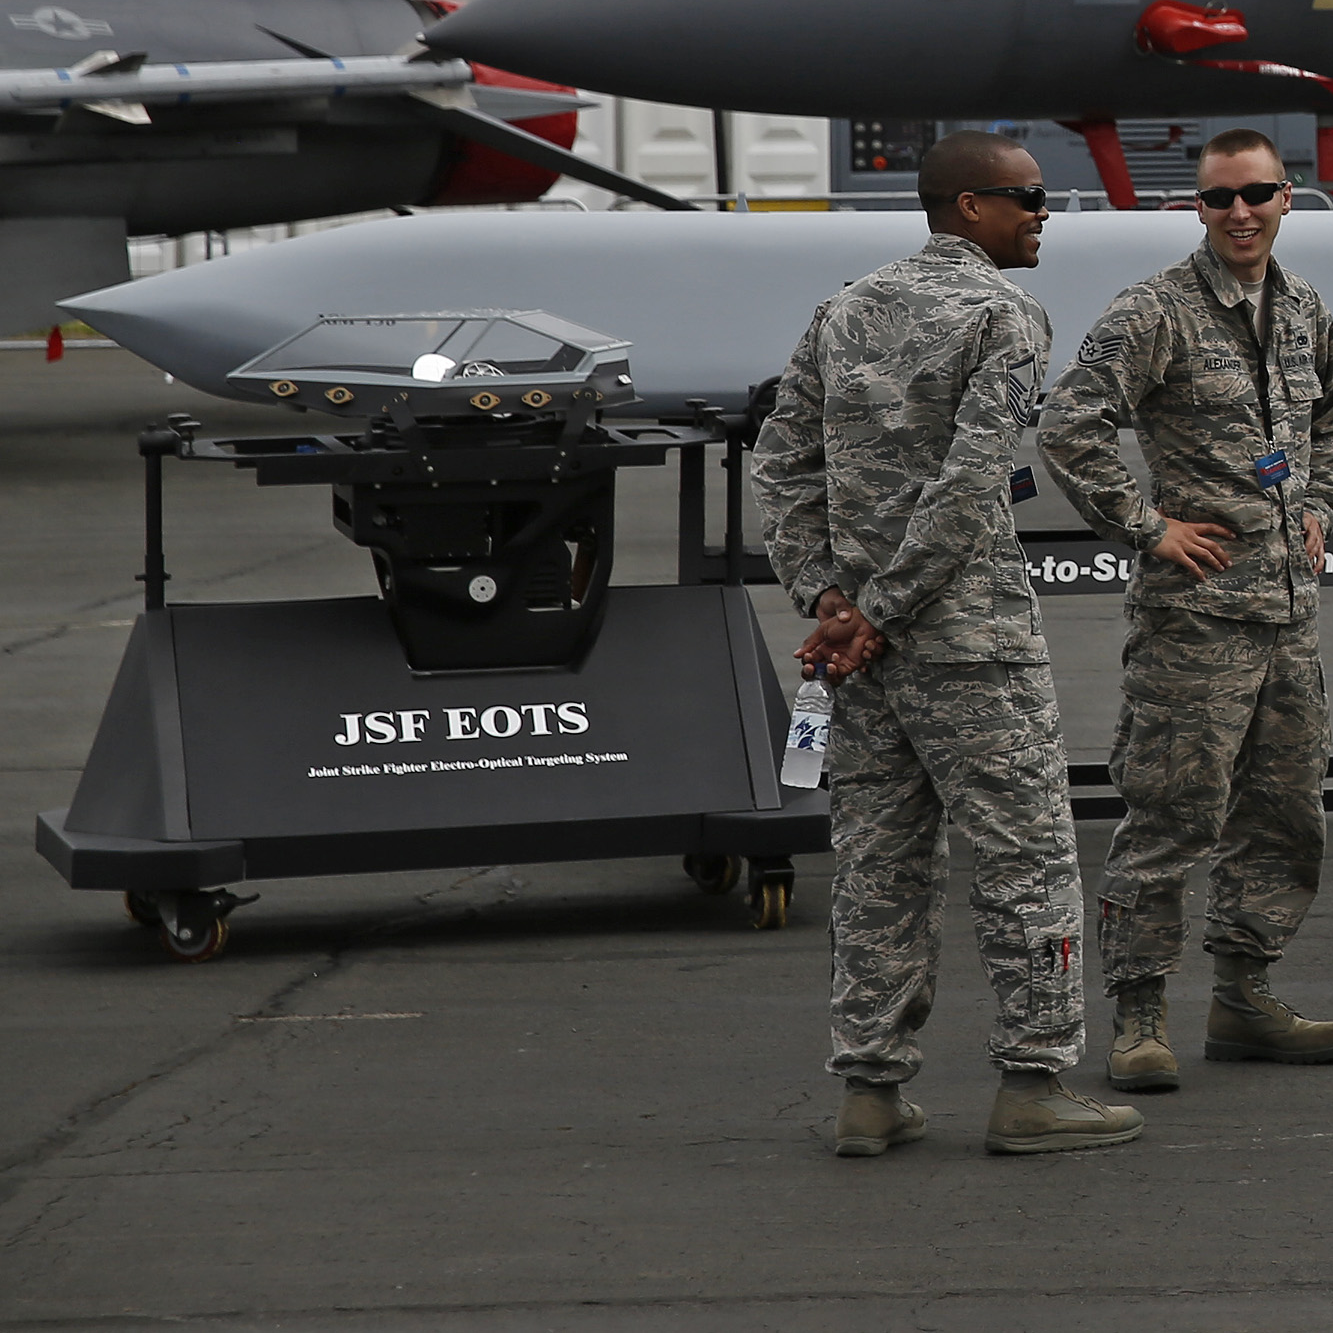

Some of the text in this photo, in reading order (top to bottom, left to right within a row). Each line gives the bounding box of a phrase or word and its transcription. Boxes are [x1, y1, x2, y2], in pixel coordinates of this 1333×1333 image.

[1026, 552, 1134, 583] -to-Su
[334, 701, 590, 746] JSF EOTS
[307, 749, 628, 779] Joint Strike Fighter Electro-Optical Targeting System
